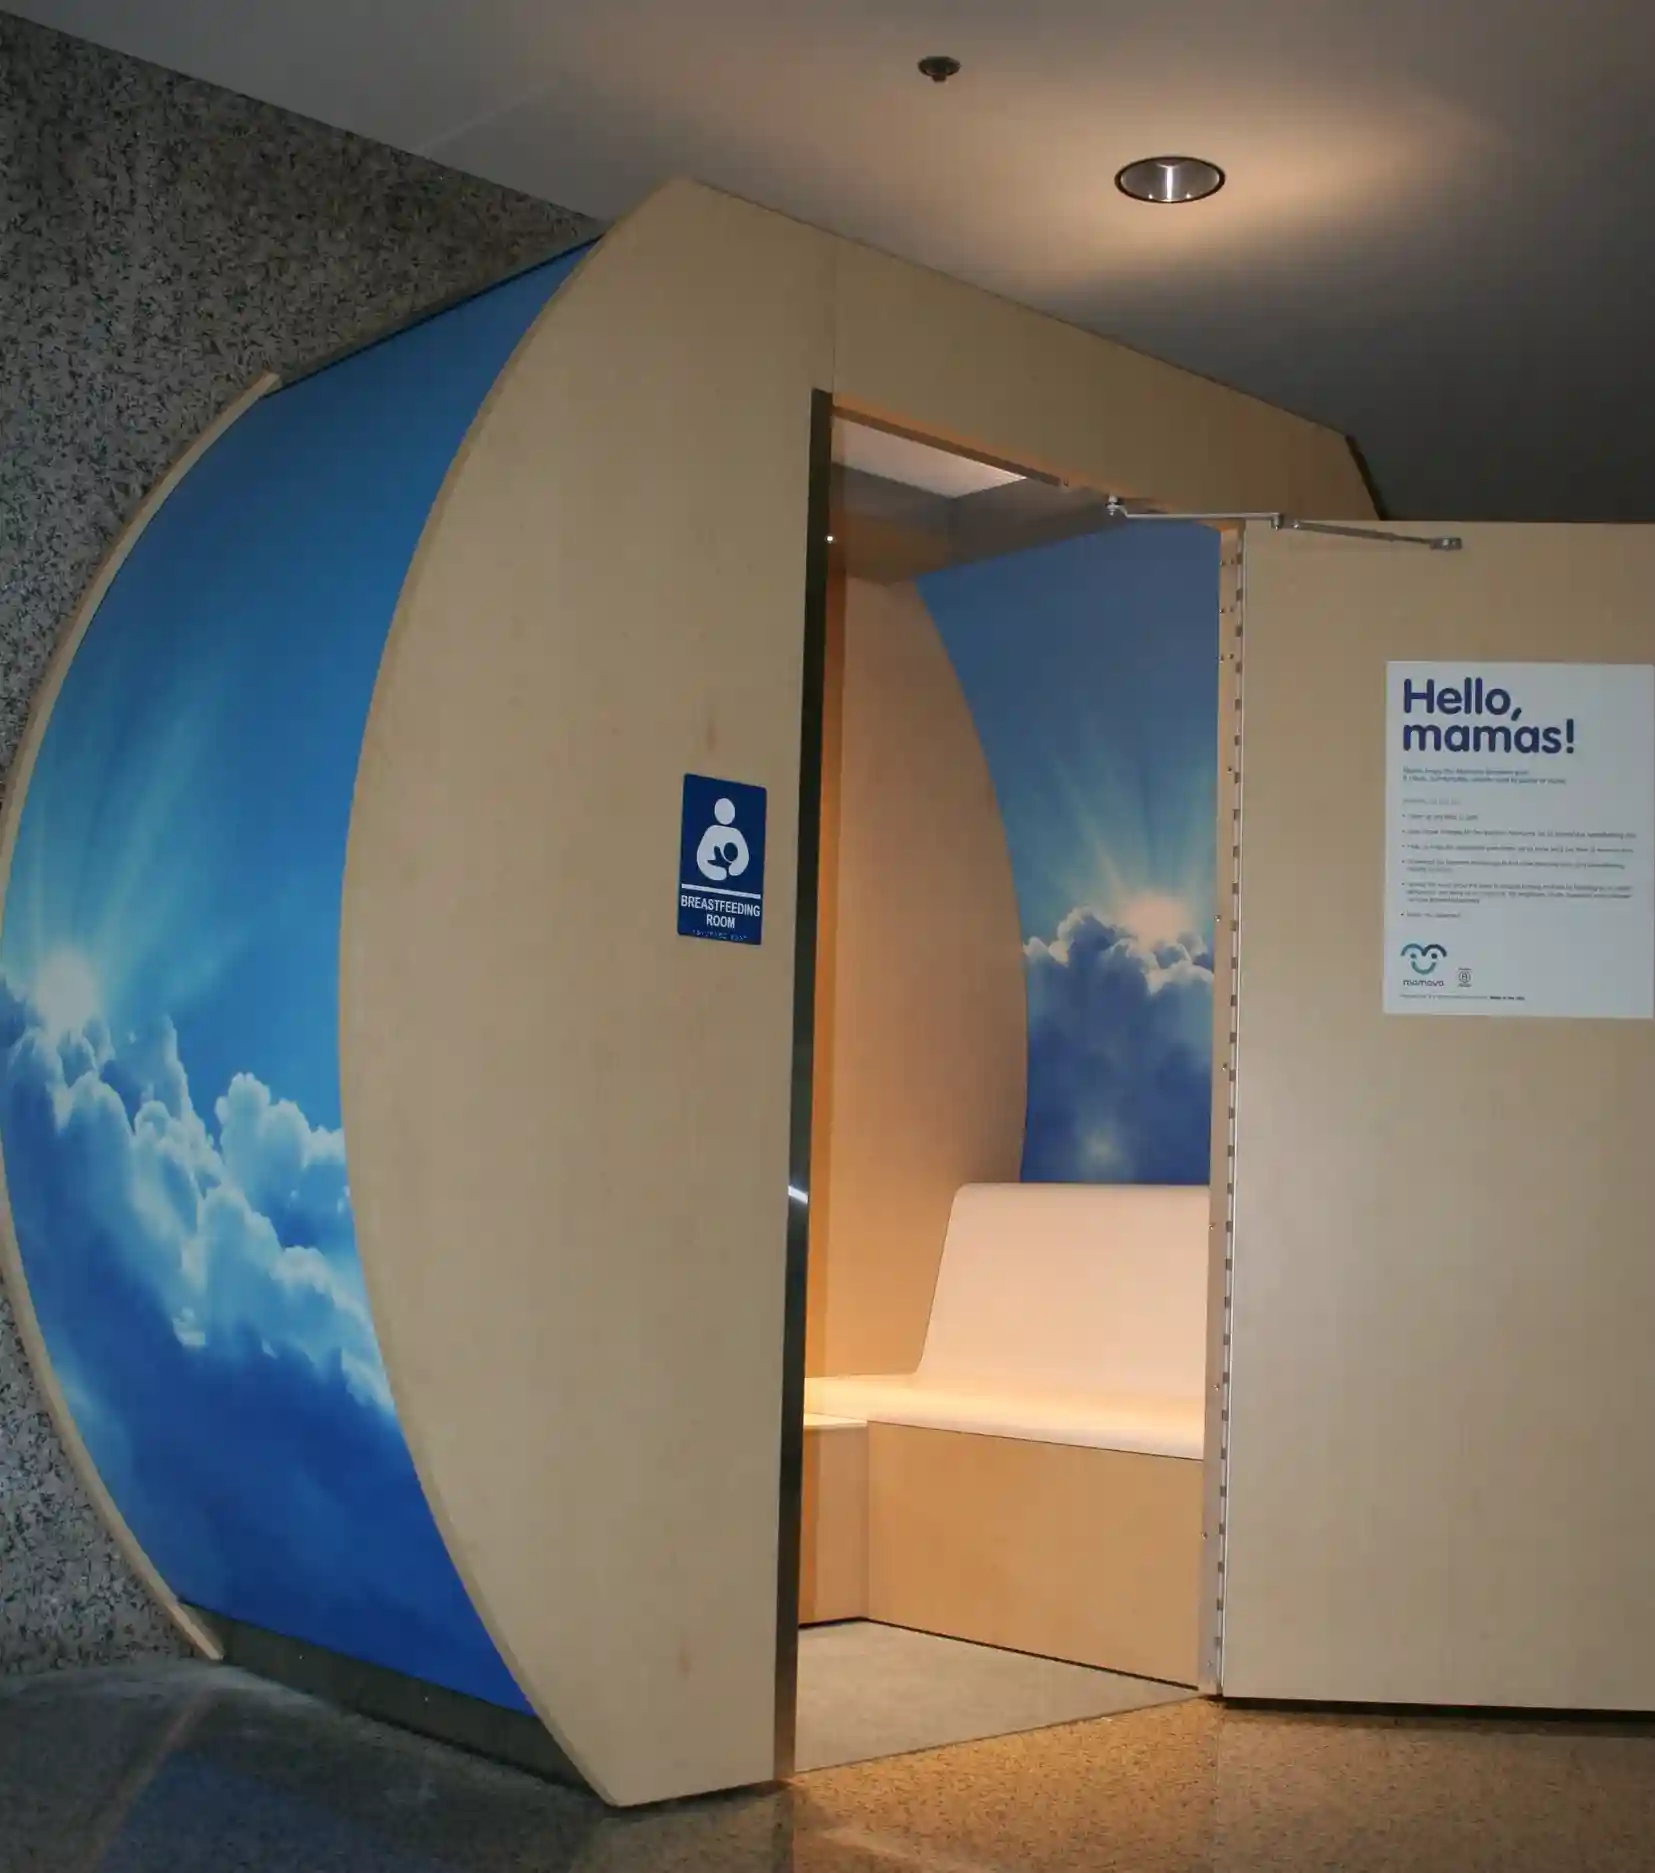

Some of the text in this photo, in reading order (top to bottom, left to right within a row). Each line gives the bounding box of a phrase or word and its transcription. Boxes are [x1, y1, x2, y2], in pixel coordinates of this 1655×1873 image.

[1403, 677, 1522, 721] Hello,
[1403, 718, 1574, 754] mamas!
[681, 895, 761, 917] BREASTFEEDING
[706, 914, 736, 929] ROOM
